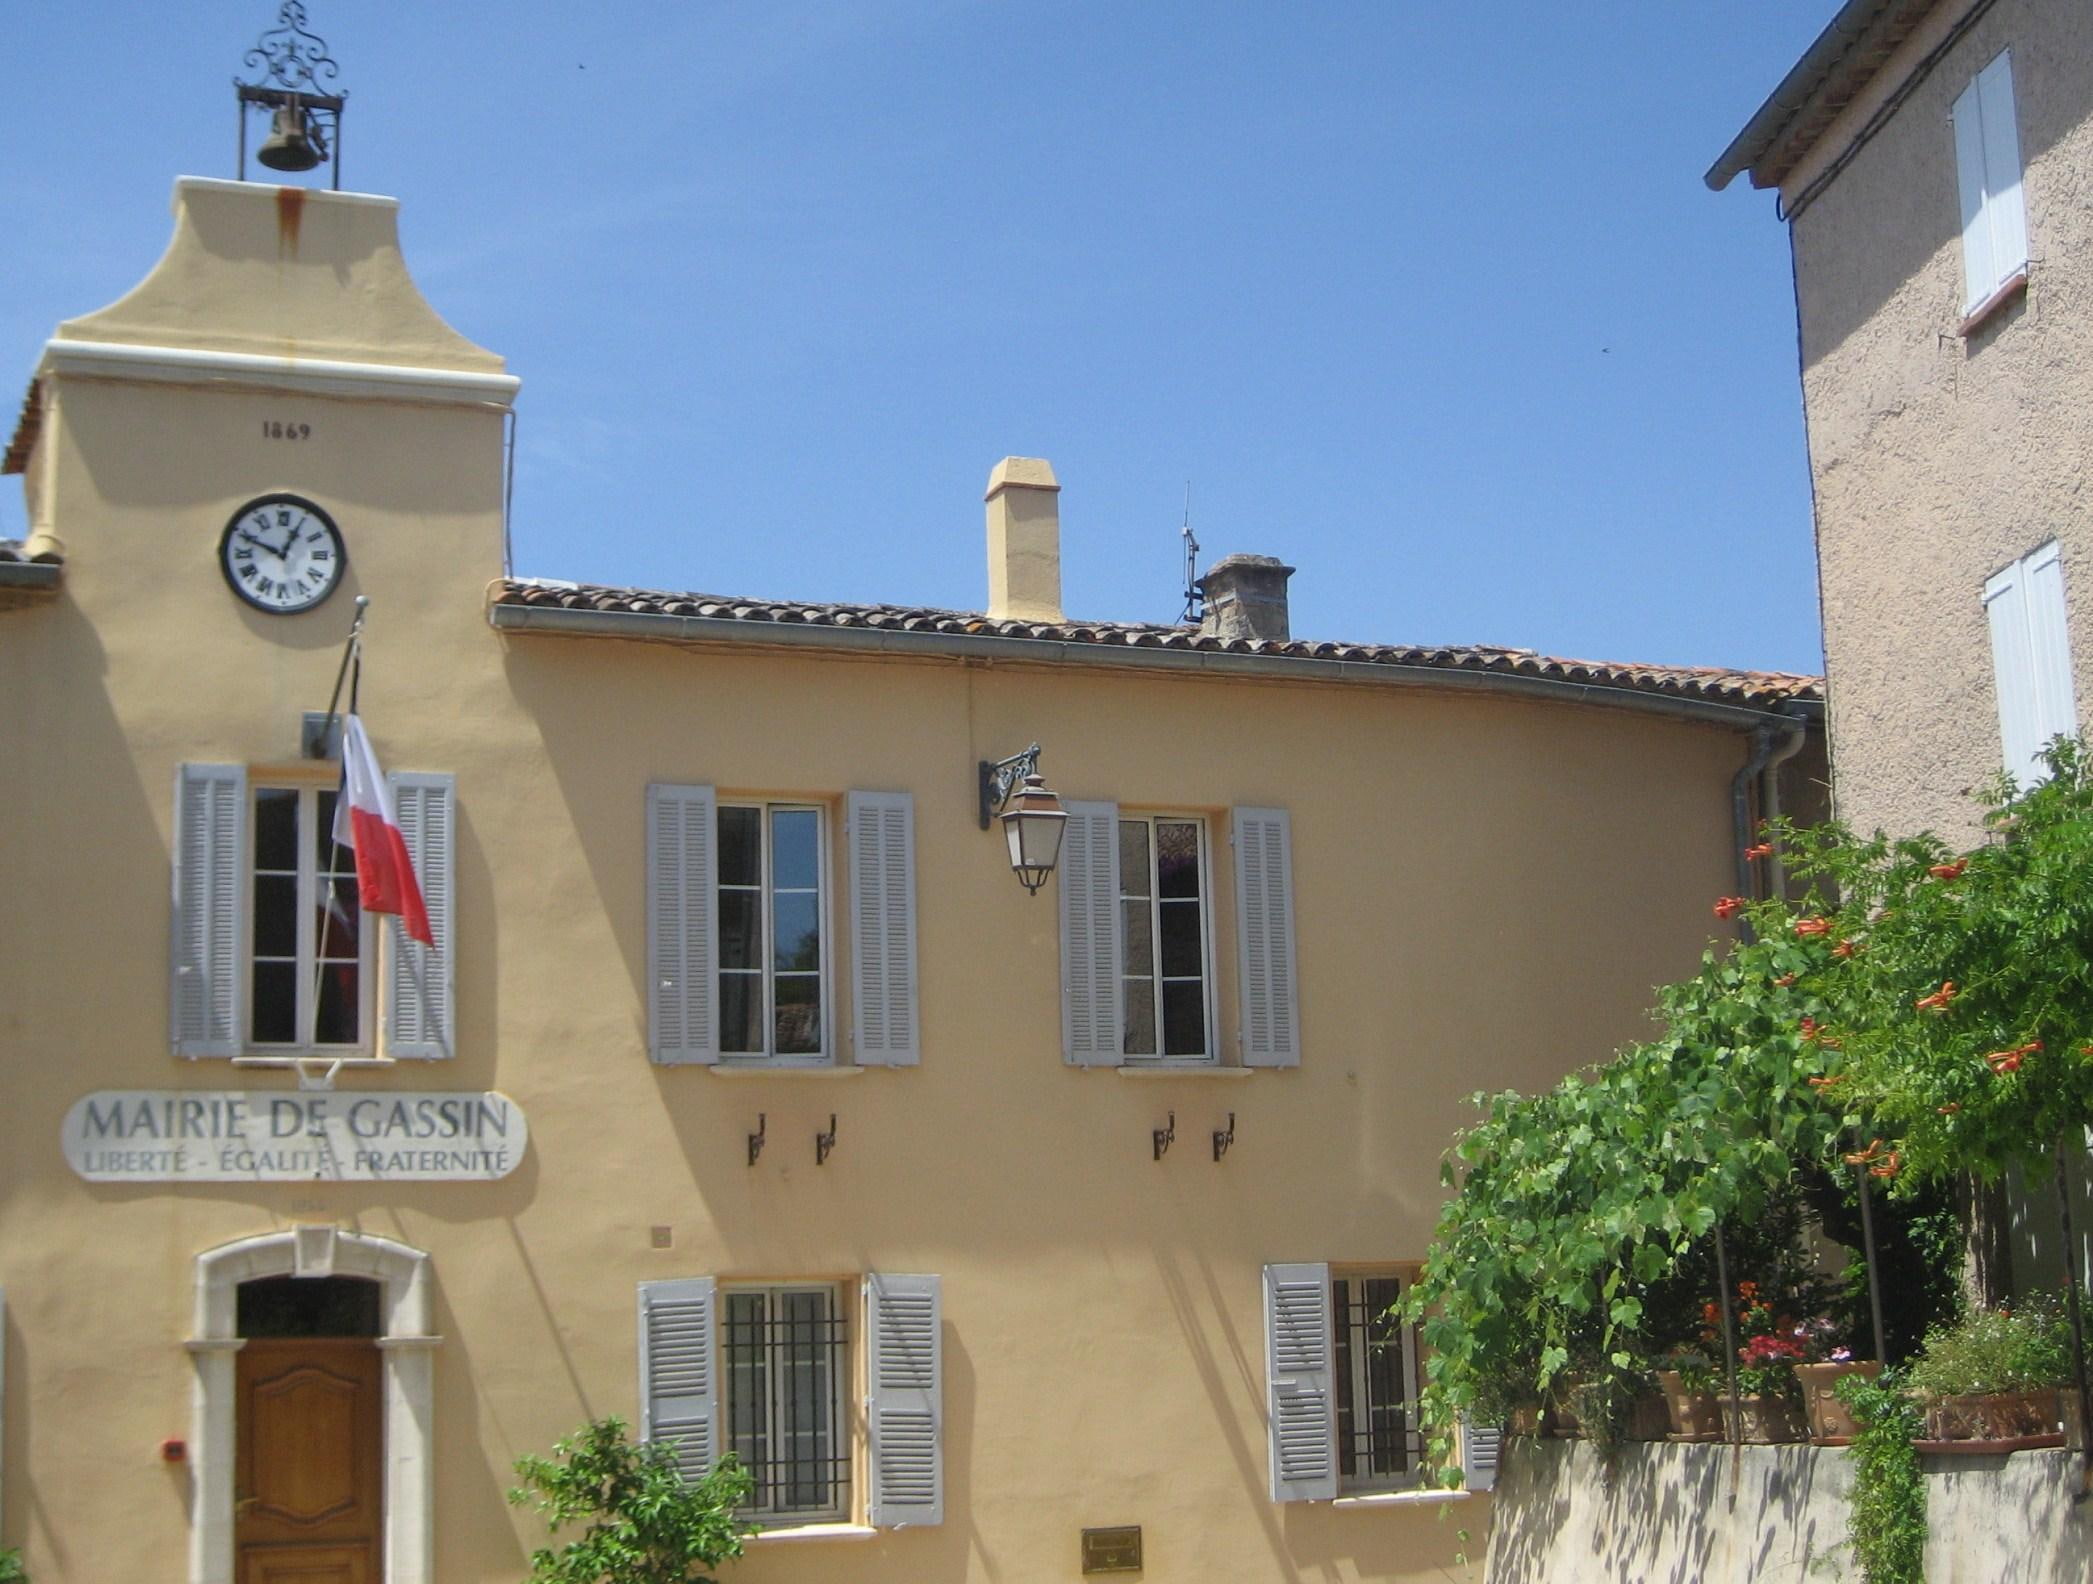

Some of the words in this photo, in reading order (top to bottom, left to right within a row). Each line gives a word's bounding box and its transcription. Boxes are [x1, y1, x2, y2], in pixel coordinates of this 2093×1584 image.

[263, 420, 311, 440] 1869
[82, 1099, 247, 1139] MAIRIE
[269, 1099, 328, 1138] DE
[347, 1098, 508, 1139] GASSIN
[82, 1143, 189, 1173] LIBERTÉ
[219, 1143, 330, 1172] ÉGALITÉ
[354, 1143, 509, 1173] FRATERNITÉ
